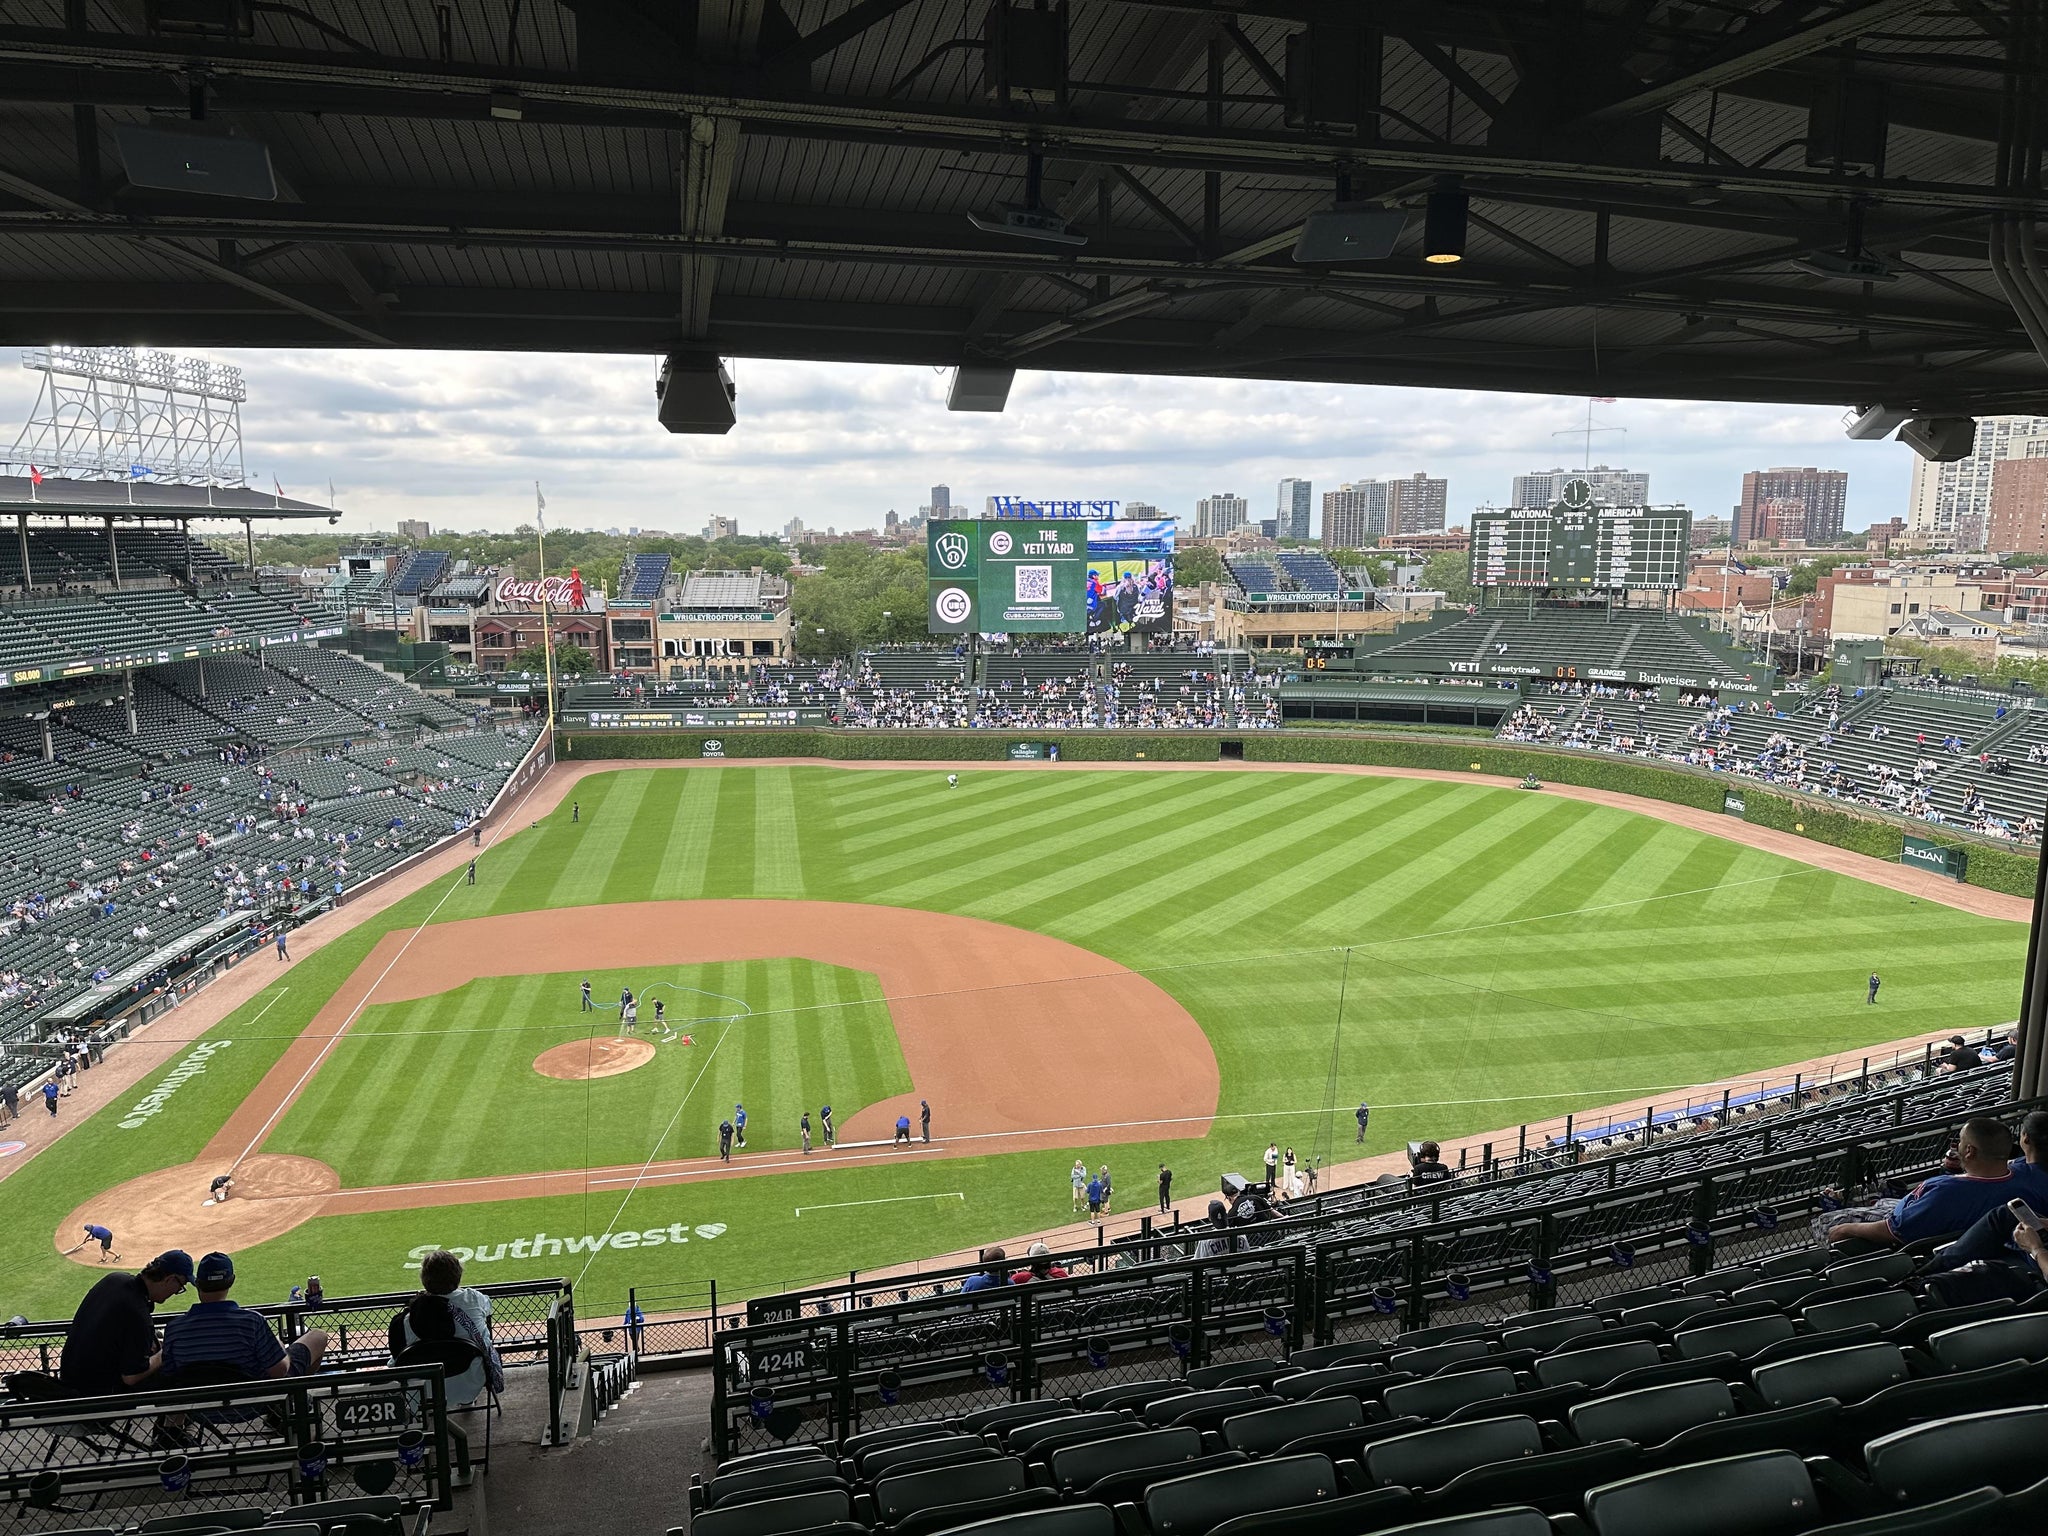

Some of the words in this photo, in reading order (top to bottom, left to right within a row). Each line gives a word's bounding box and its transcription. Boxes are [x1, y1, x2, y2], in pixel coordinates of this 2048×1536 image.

[1511, 510, 1553, 518] NATIONAL
[1598, 508, 1644, 517] AMERICAN
[1038, 530, 1058, 541] THE
[1023, 544, 1045, 554] YETI
[1047, 543, 1074, 554] YARD
[496, 576, 575, 603] Coca-Cola
[1133, 602, 1165, 621] Yard
[1307, 658, 1325, 669] 0:15
[1449, 662, 1480, 672] YETI
[1497, 666, 1540, 674] tastytrade
[1588, 668, 1626, 677] GRAINGER
[1719, 680, 1758, 692] Advocate
[1726, 798, 1745, 811] Hefty
[402, 1222, 689, 1269] Southwest
[759, 1351, 804, 1372] 424R
[344, 1403, 396, 1423] 423R
